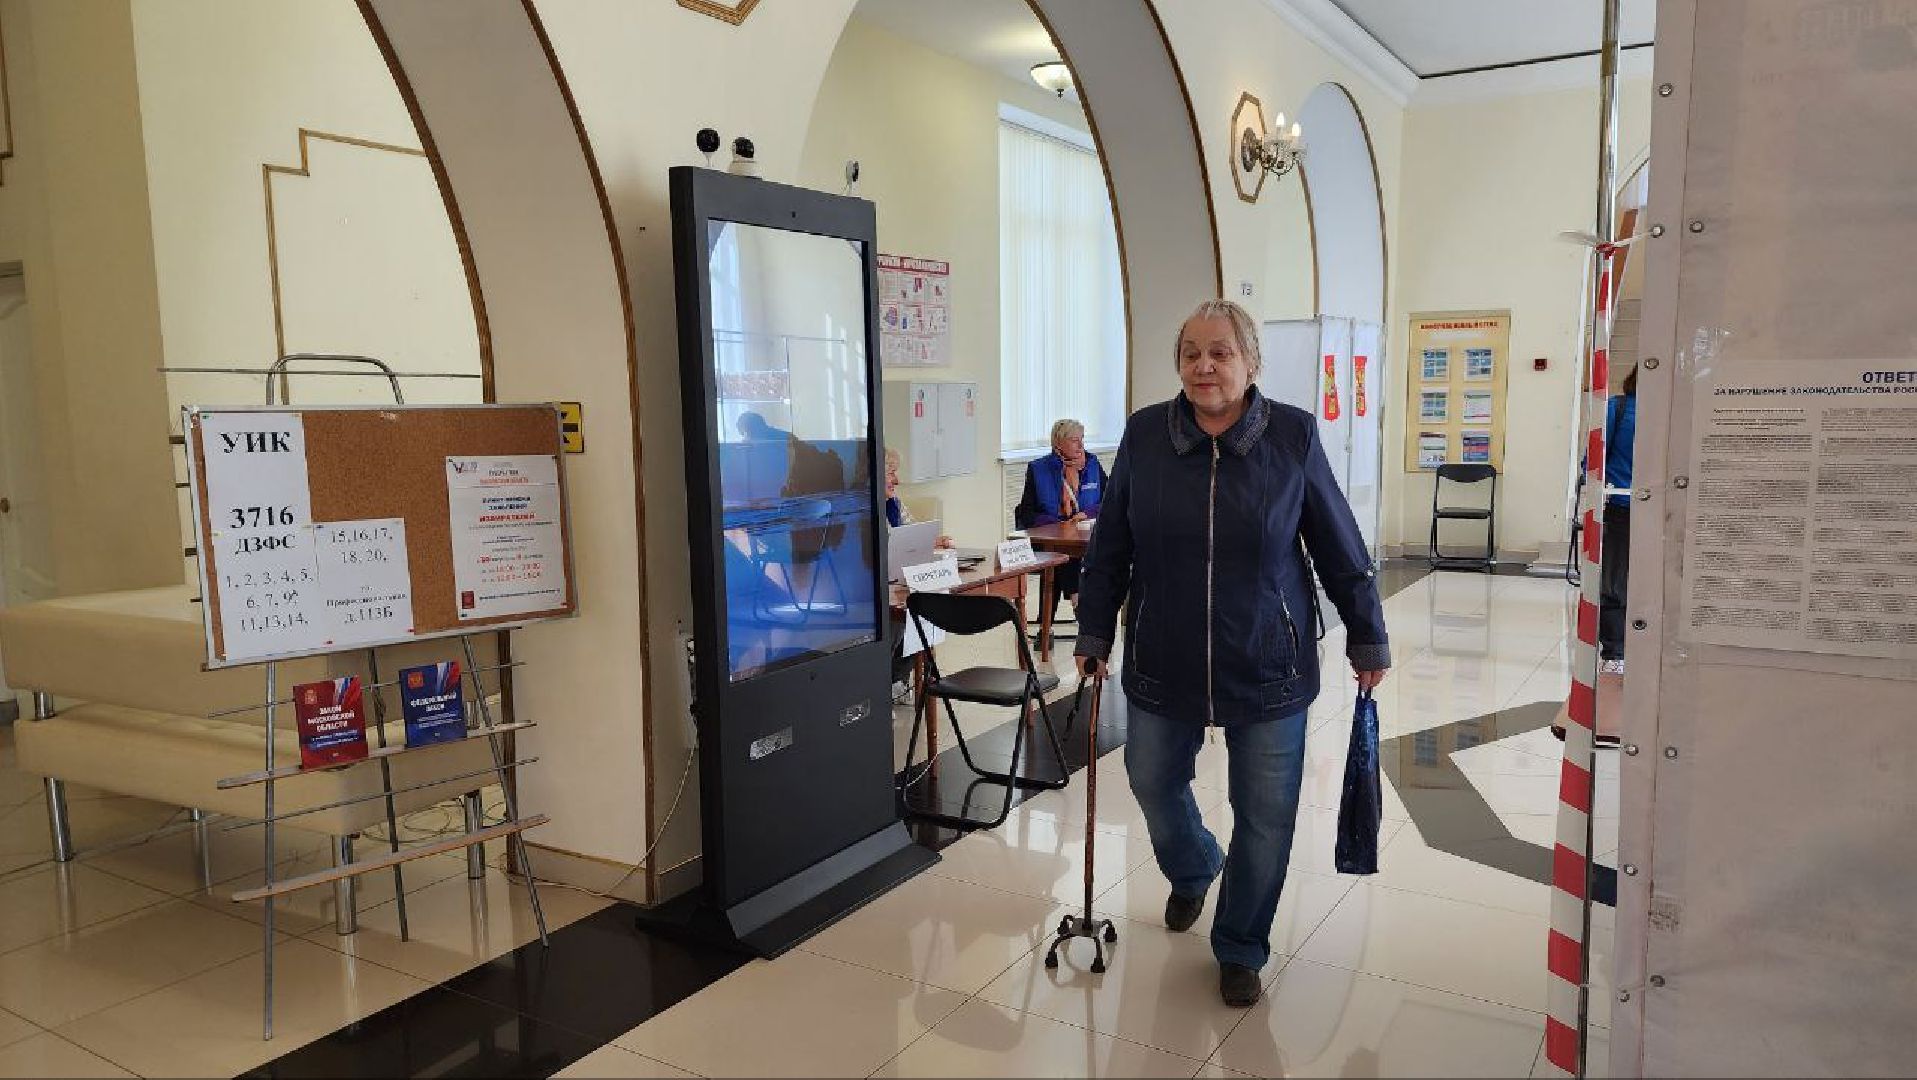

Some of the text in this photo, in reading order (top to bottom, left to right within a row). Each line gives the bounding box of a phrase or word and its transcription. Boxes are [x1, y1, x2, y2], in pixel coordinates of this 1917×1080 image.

[1790, 386, 1891, 396] ЗАКОНОДАТЕЛЬСТВА
[220, 431, 291, 453] УИК
[229, 505, 294, 529] 3716
[235, 533, 296, 555] ДЗФС
